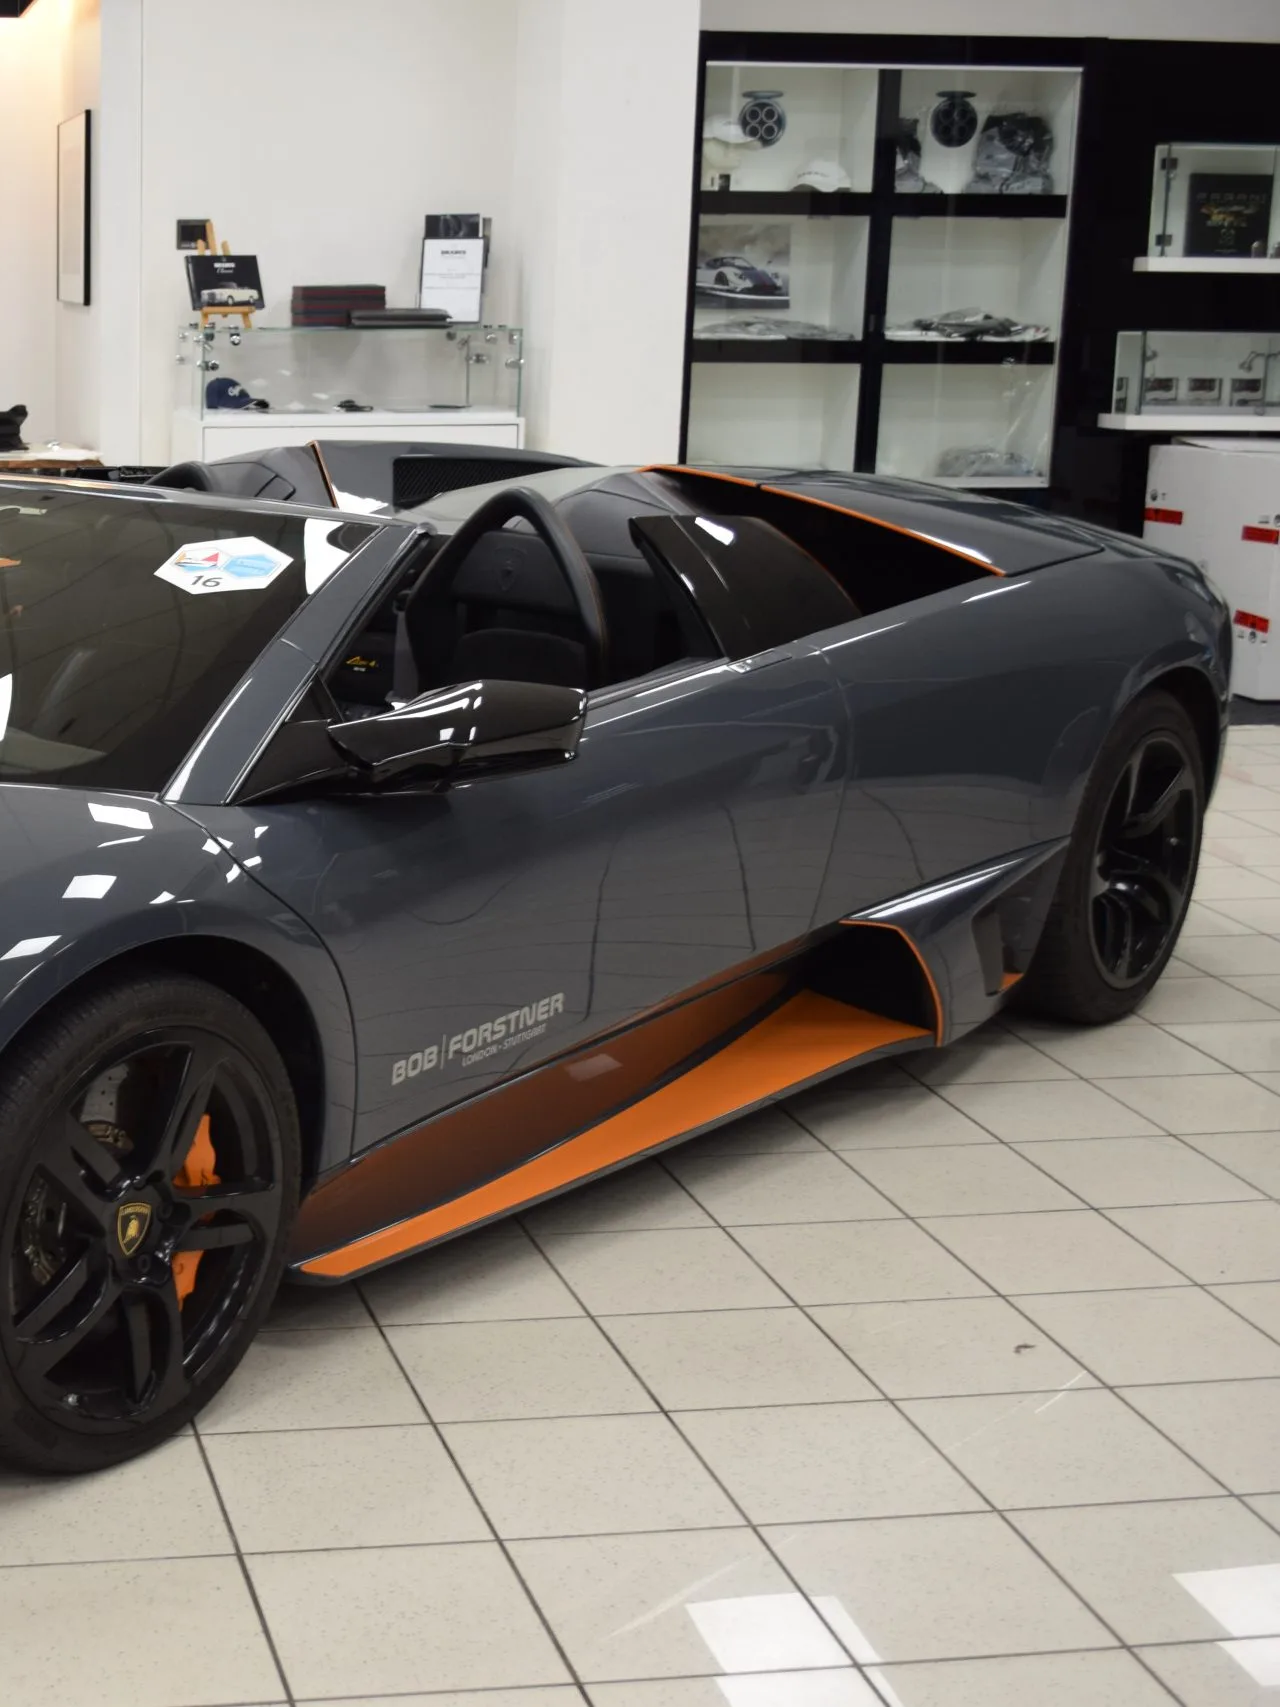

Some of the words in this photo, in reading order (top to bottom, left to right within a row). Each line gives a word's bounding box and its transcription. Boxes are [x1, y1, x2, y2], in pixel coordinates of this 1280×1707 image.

[191, 575, 223, 588] 16
[391, 1044, 438, 1086] BOB
[448, 992, 565, 1060] FORSTNER
